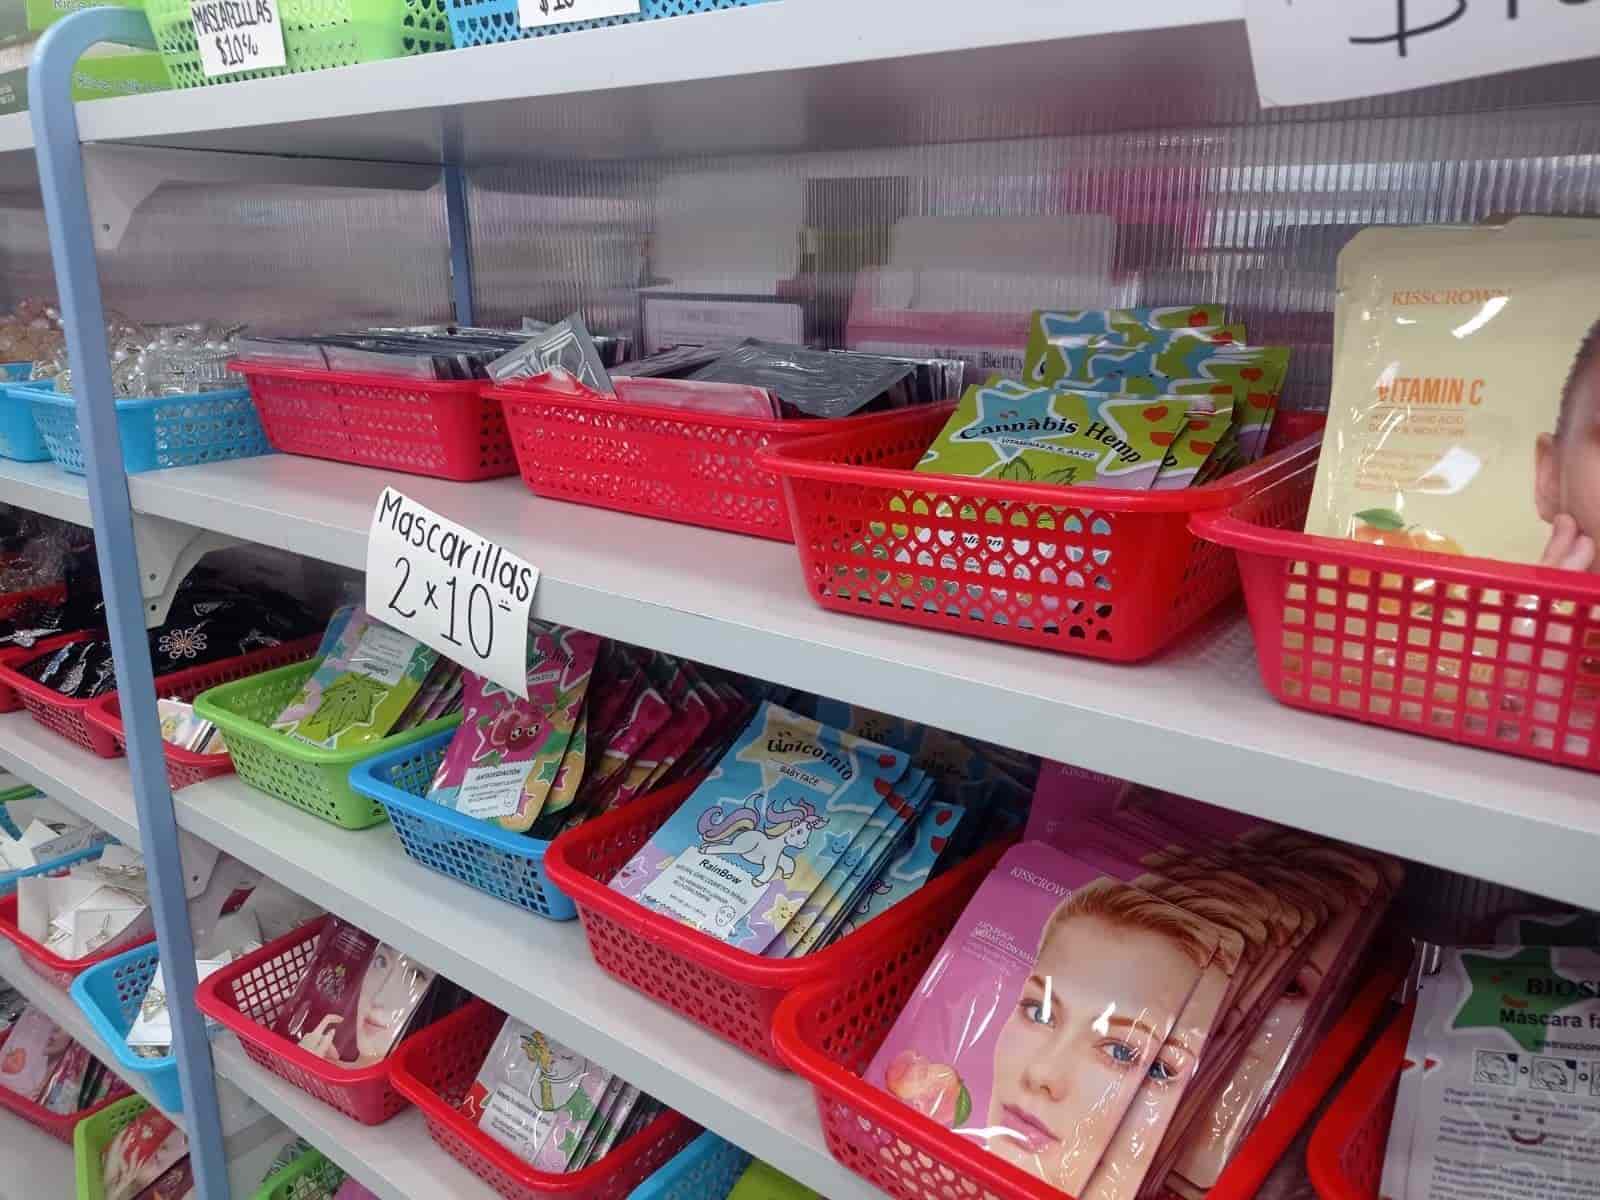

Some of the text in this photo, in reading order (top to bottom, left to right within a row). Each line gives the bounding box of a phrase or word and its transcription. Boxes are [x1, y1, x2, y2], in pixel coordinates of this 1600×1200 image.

[1469, 379, 1485, 405] C
[959, 416, 1079, 440] Cannabis
[1084, 421, 1142, 464] Hemp
[379, 490, 531, 602] Mascarillas
[767, 736, 853, 781] Unicornio
[698, 858, 742, 885] RainBow
[1527, 976, 1600, 999] BIOS
